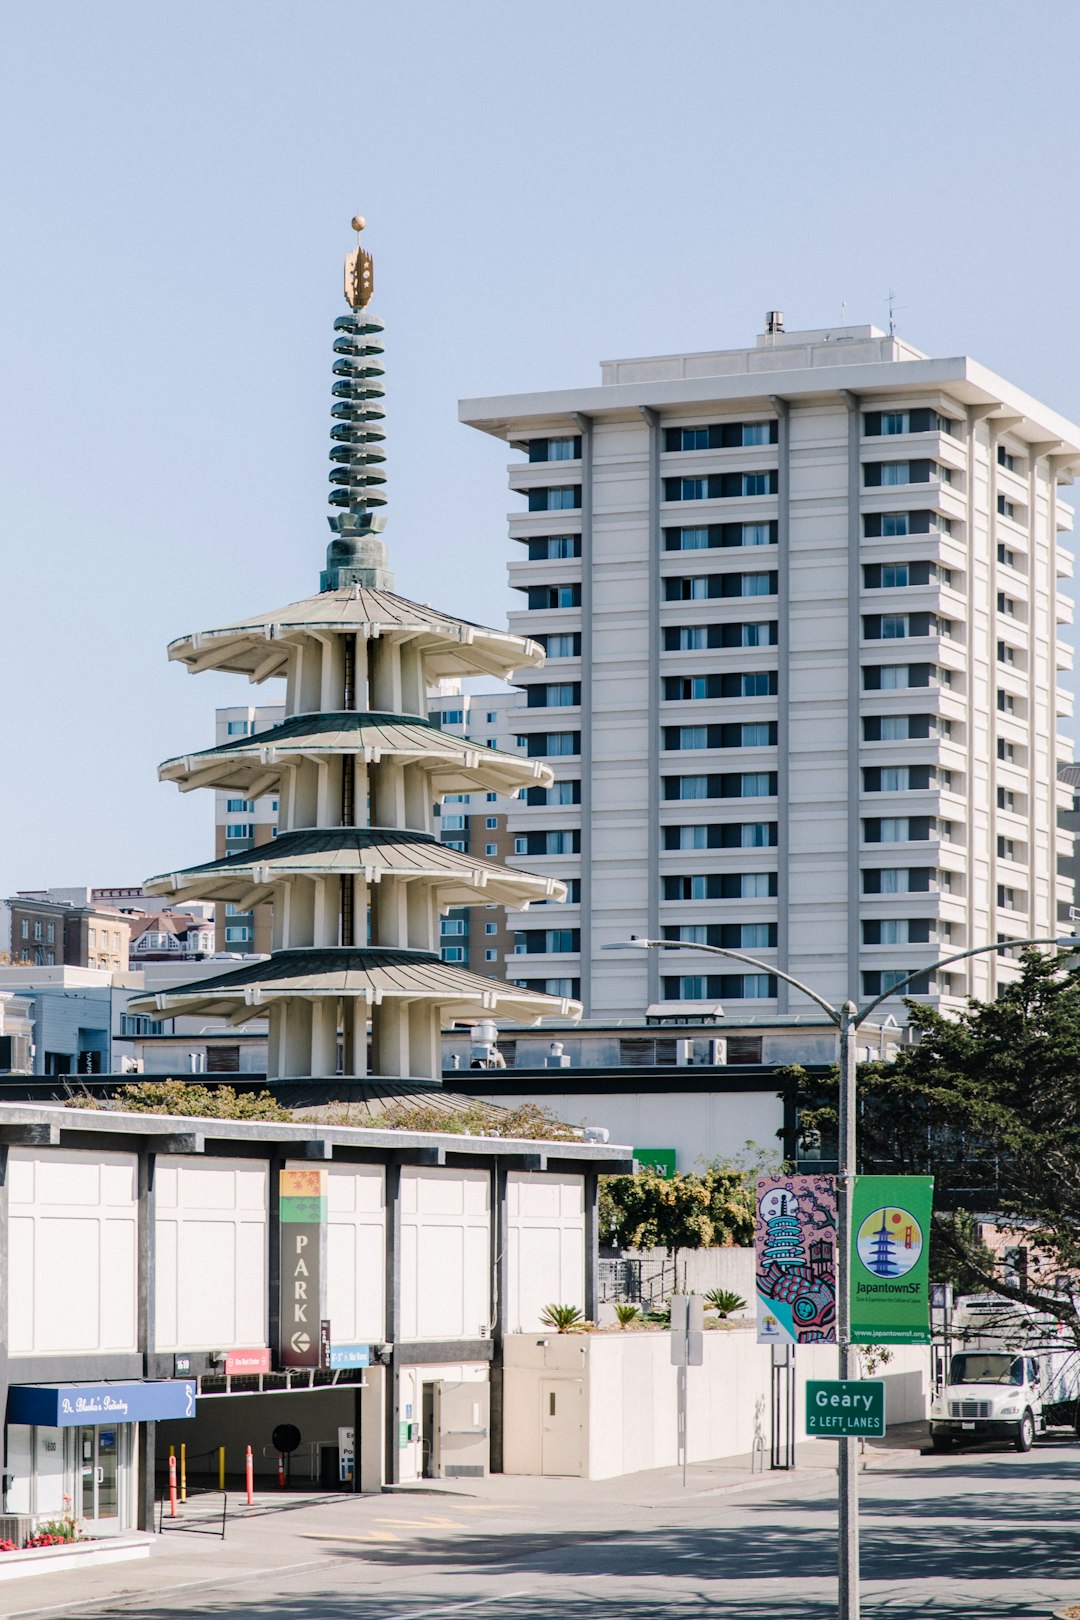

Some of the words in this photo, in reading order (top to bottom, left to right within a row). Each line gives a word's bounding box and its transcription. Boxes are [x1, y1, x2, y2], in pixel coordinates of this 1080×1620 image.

[293, 1235, 309, 1322] PARK
[856, 1282, 921, 1294] JapantownSF
[854, 1330, 925, 1338] www.japantownsf.org
[816, 1390, 873, 1411] Geary
[809, 1416, 816, 1427] 2
[819, 1416, 843, 1427] LEFT
[847, 1417, 880, 1428] LANES
